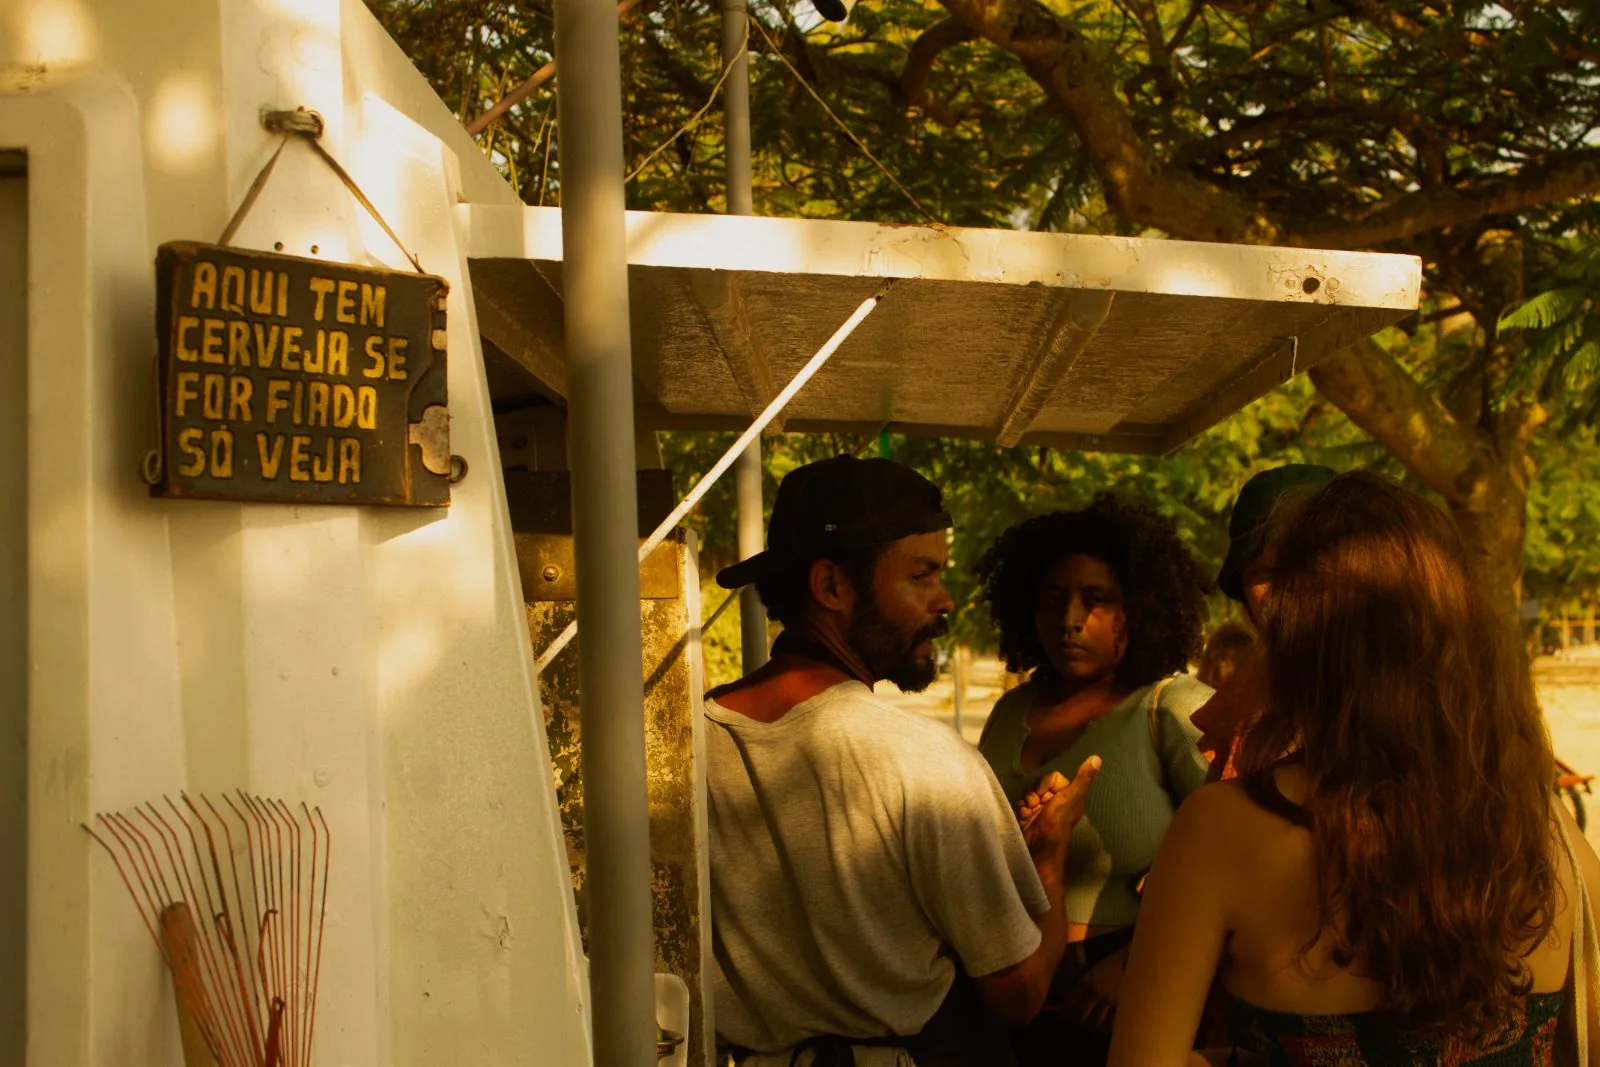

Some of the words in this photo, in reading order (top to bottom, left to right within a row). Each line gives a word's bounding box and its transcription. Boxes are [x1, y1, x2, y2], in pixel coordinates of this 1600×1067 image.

[190, 261, 290, 318] AQUI
[308, 276, 387, 328] TEM
[175, 315, 350, 376] CERVEJA
[361, 335, 409, 381] SE
[175, 371, 254, 422] FOR
[265, 378, 377, 430] FIADO
[256, 432, 361, 484] VEJA
